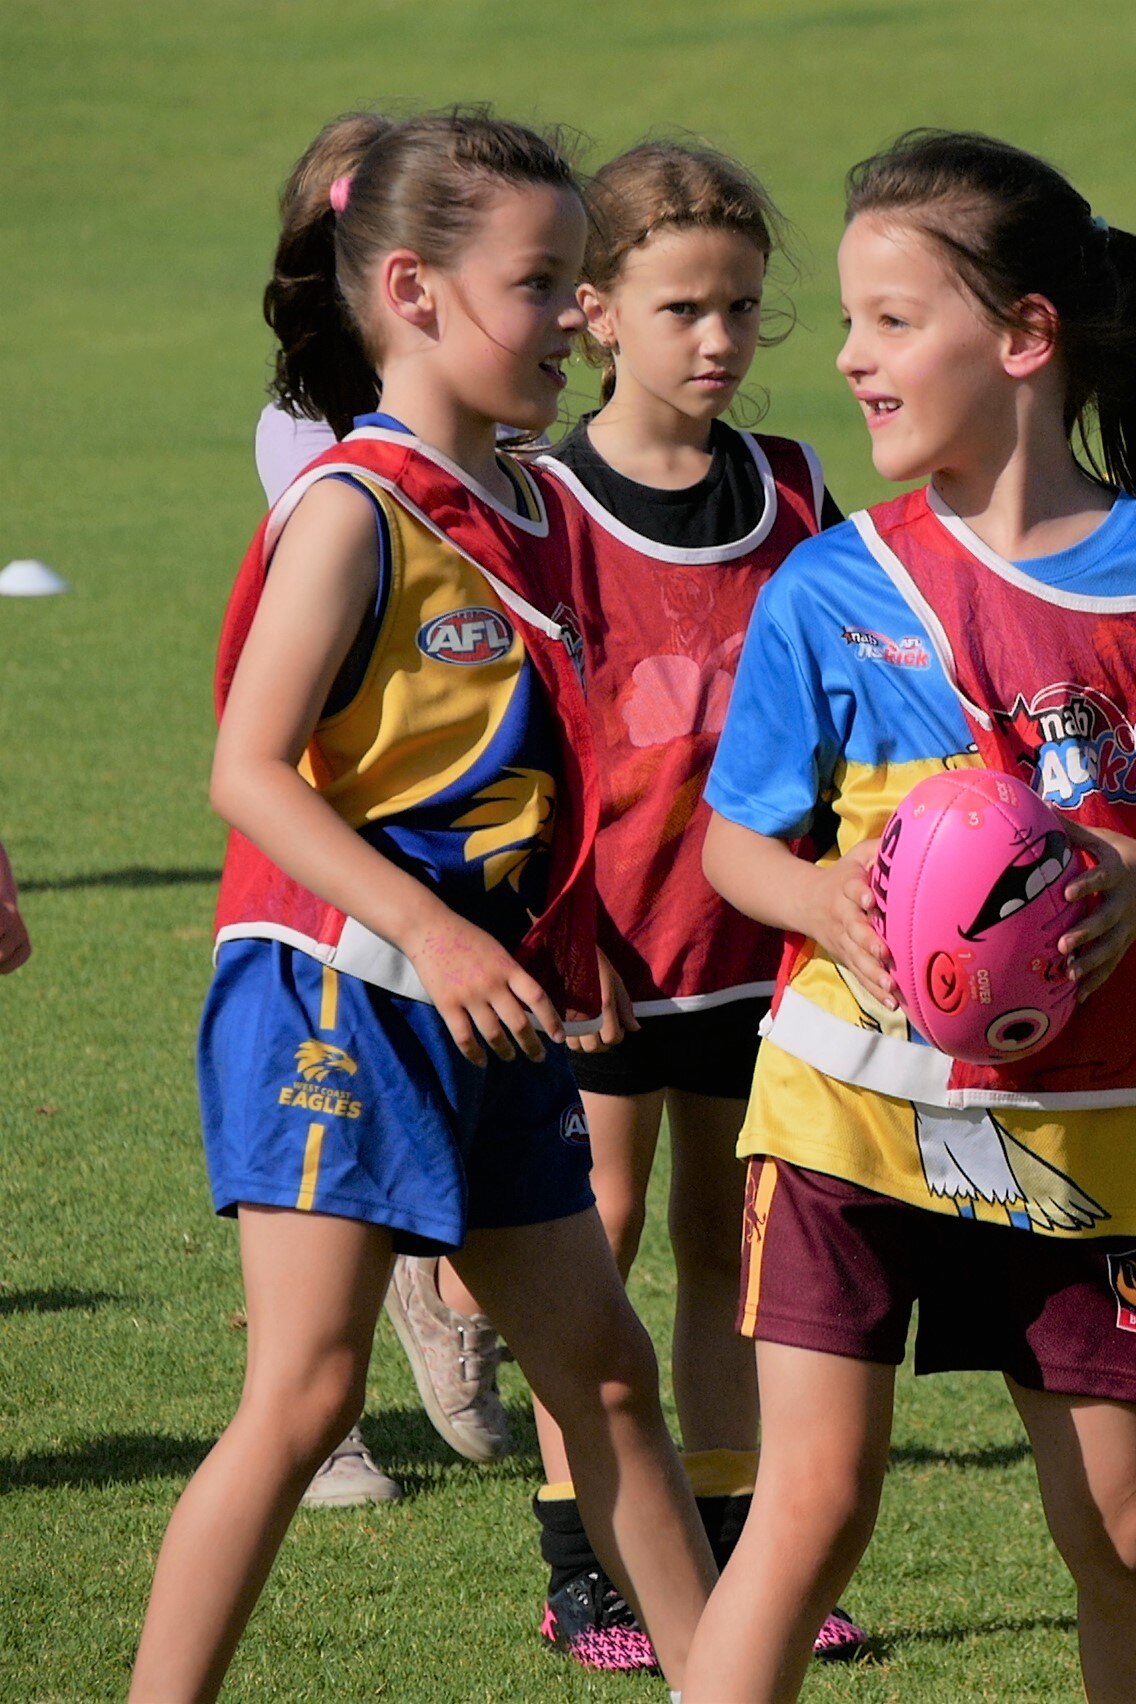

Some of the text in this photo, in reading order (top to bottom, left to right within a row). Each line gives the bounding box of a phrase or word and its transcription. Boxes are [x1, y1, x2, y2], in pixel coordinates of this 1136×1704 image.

[427, 620, 510, 652] AFL
[851, 632, 877, 645] nab
[1040, 701, 1089, 741] nab
[977, 970, 991, 1004] COVER
[279, 1087, 362, 1119] EAGLES
